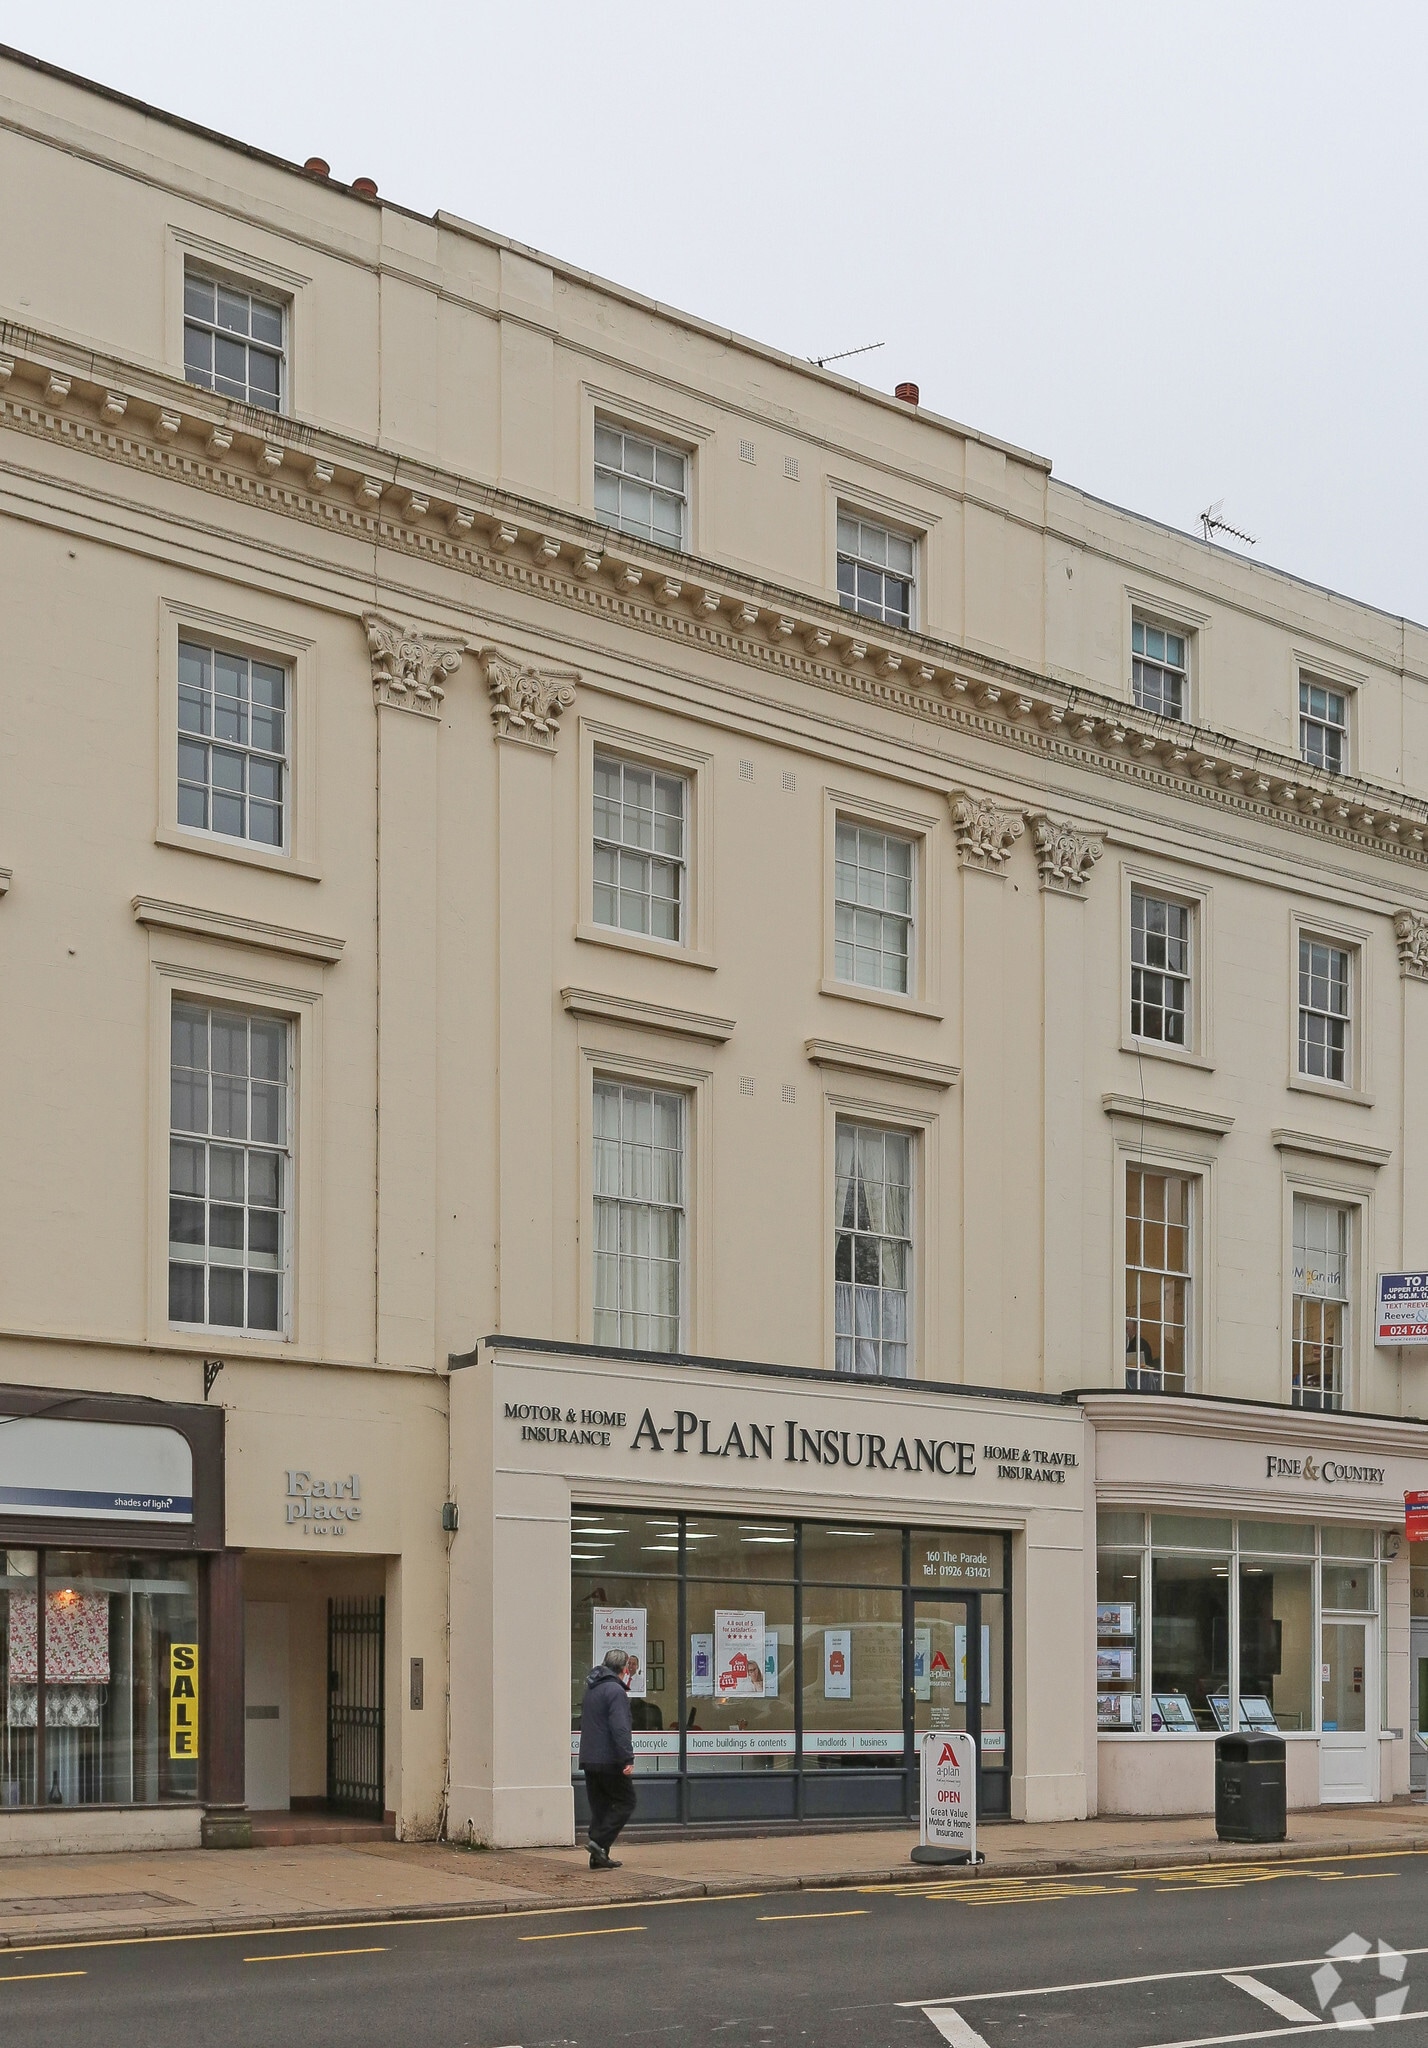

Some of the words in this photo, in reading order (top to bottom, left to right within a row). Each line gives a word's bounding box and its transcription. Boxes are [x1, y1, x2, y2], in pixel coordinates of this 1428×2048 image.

[1404, 1276, 1421, 1286] TO
[1384, 1312, 1415, 1320] Reeves
[1390, 1326, 1407, 1335] 024
[1410, 1325, 1428, 1335] 766
[504, 1402, 562, 1422] MOTOR
[566, 1408, 577, 1423] &
[581, 1409, 627, 1427] HOME
[521, 1425, 611, 1447] INSURANCE
[785, 1420, 977, 1476] INSURANCE
[984, 1445, 1020, 1461] HOME
[1022, 1449, 1031, 1462] &
[1033, 1450, 1079, 1467] TRAVEL
[998, 1465, 1066, 1483] INSURANCE
[286, 1469, 361, 1500] Earl
[114, 1498, 141, 1508] shades
[142, 1499, 151, 1508] of
[152, 1498, 170, 1510] light
[286, 1496, 362, 1524] place
[313, 1524, 328, 1535] to
[332, 1524, 345, 1536] 10
[926, 1551, 940, 1562] 160
[943, 1551, 957, 1562] The
[960, 1552, 987, 1564] Parade
[923, 1564, 937, 1575] Tel:
[939, 1565, 962, 1577] 01926
[965, 1567, 991, 1578] 431421
[1413, 1587, 1425, 1598] 158
[930, 1669, 951, 1678] a-plan
[172, 1646, 196, 1754] SALE
[571, 1741, 580, 1749] ca
[692, 1738, 714, 1747] home
[716, 1738, 747, 1750] buildings
[749, 1738, 755, 1746] &
[757, 1739, 787, 1747] contents
[816, 1737, 847, 1746] landlords
[860, 1737, 888, 1746] business
[983, 1736, 1001, 1745] travel
[936, 1765, 960, 1777] a-plan
[937, 1790, 961, 1803] OPEN
[930, 1807, 948, 1817] Great
[949, 1808, 968, 1819] Value
[928, 1817, 945, 1826] Motor
[946, 1818, 952, 1827] &
[953, 1819, 971, 1829] Home
[936, 1828, 964, 1838] Insurance
